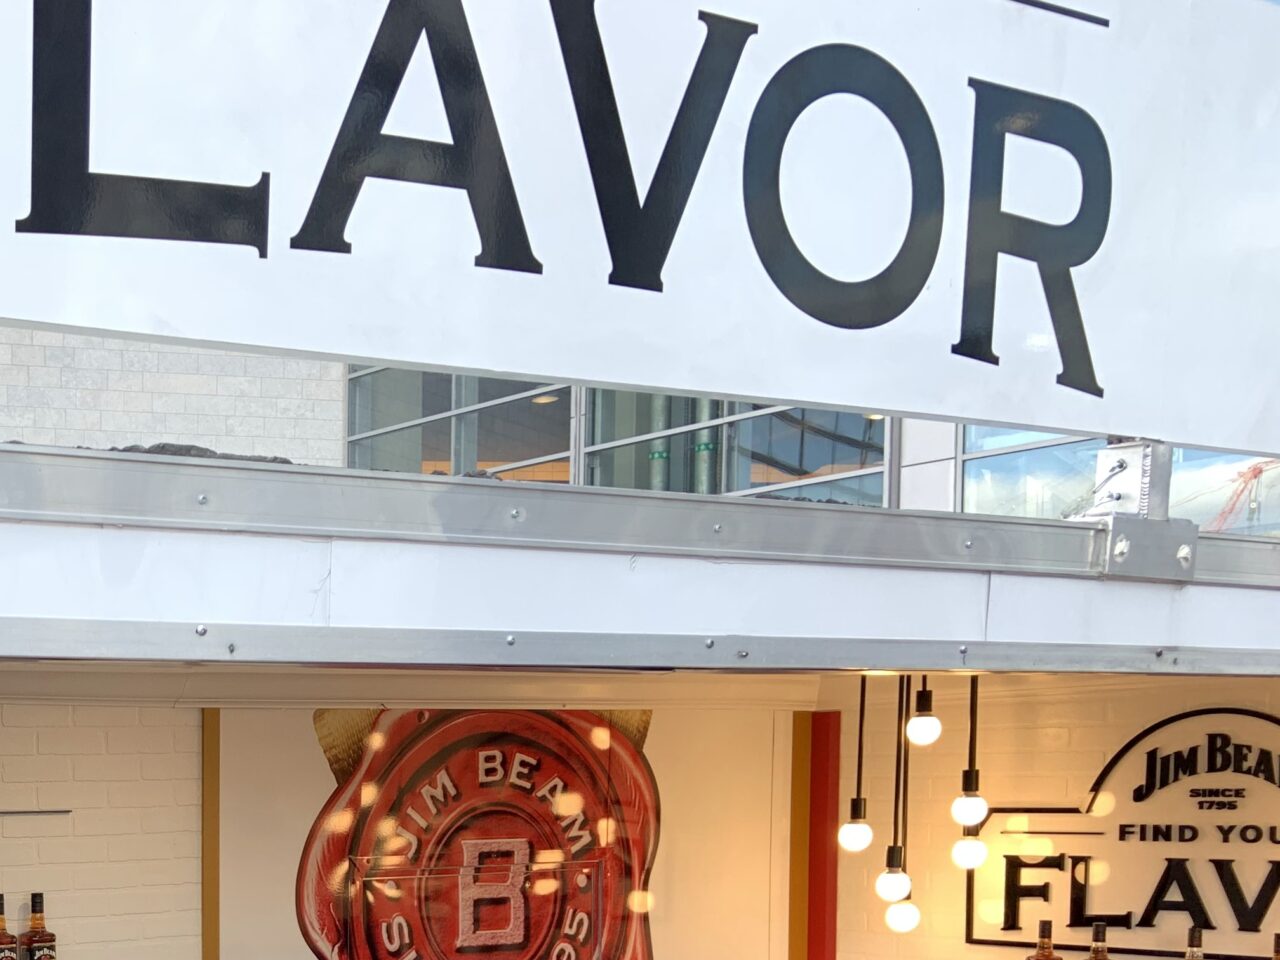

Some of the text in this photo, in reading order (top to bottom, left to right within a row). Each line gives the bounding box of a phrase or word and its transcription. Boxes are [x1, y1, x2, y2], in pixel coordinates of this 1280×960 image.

[1133, 733, 1280, 802] JIM BEA
[1189, 788, 1246, 798] SINCE
[395, 750, 592, 859] JIM BEAM
[1118, 824, 1280, 844] FIND YOU
[1197, 801, 1238, 810] 1795
[455, 838, 530, 948] B
[1000, 853, 1280, 932] FLAV
